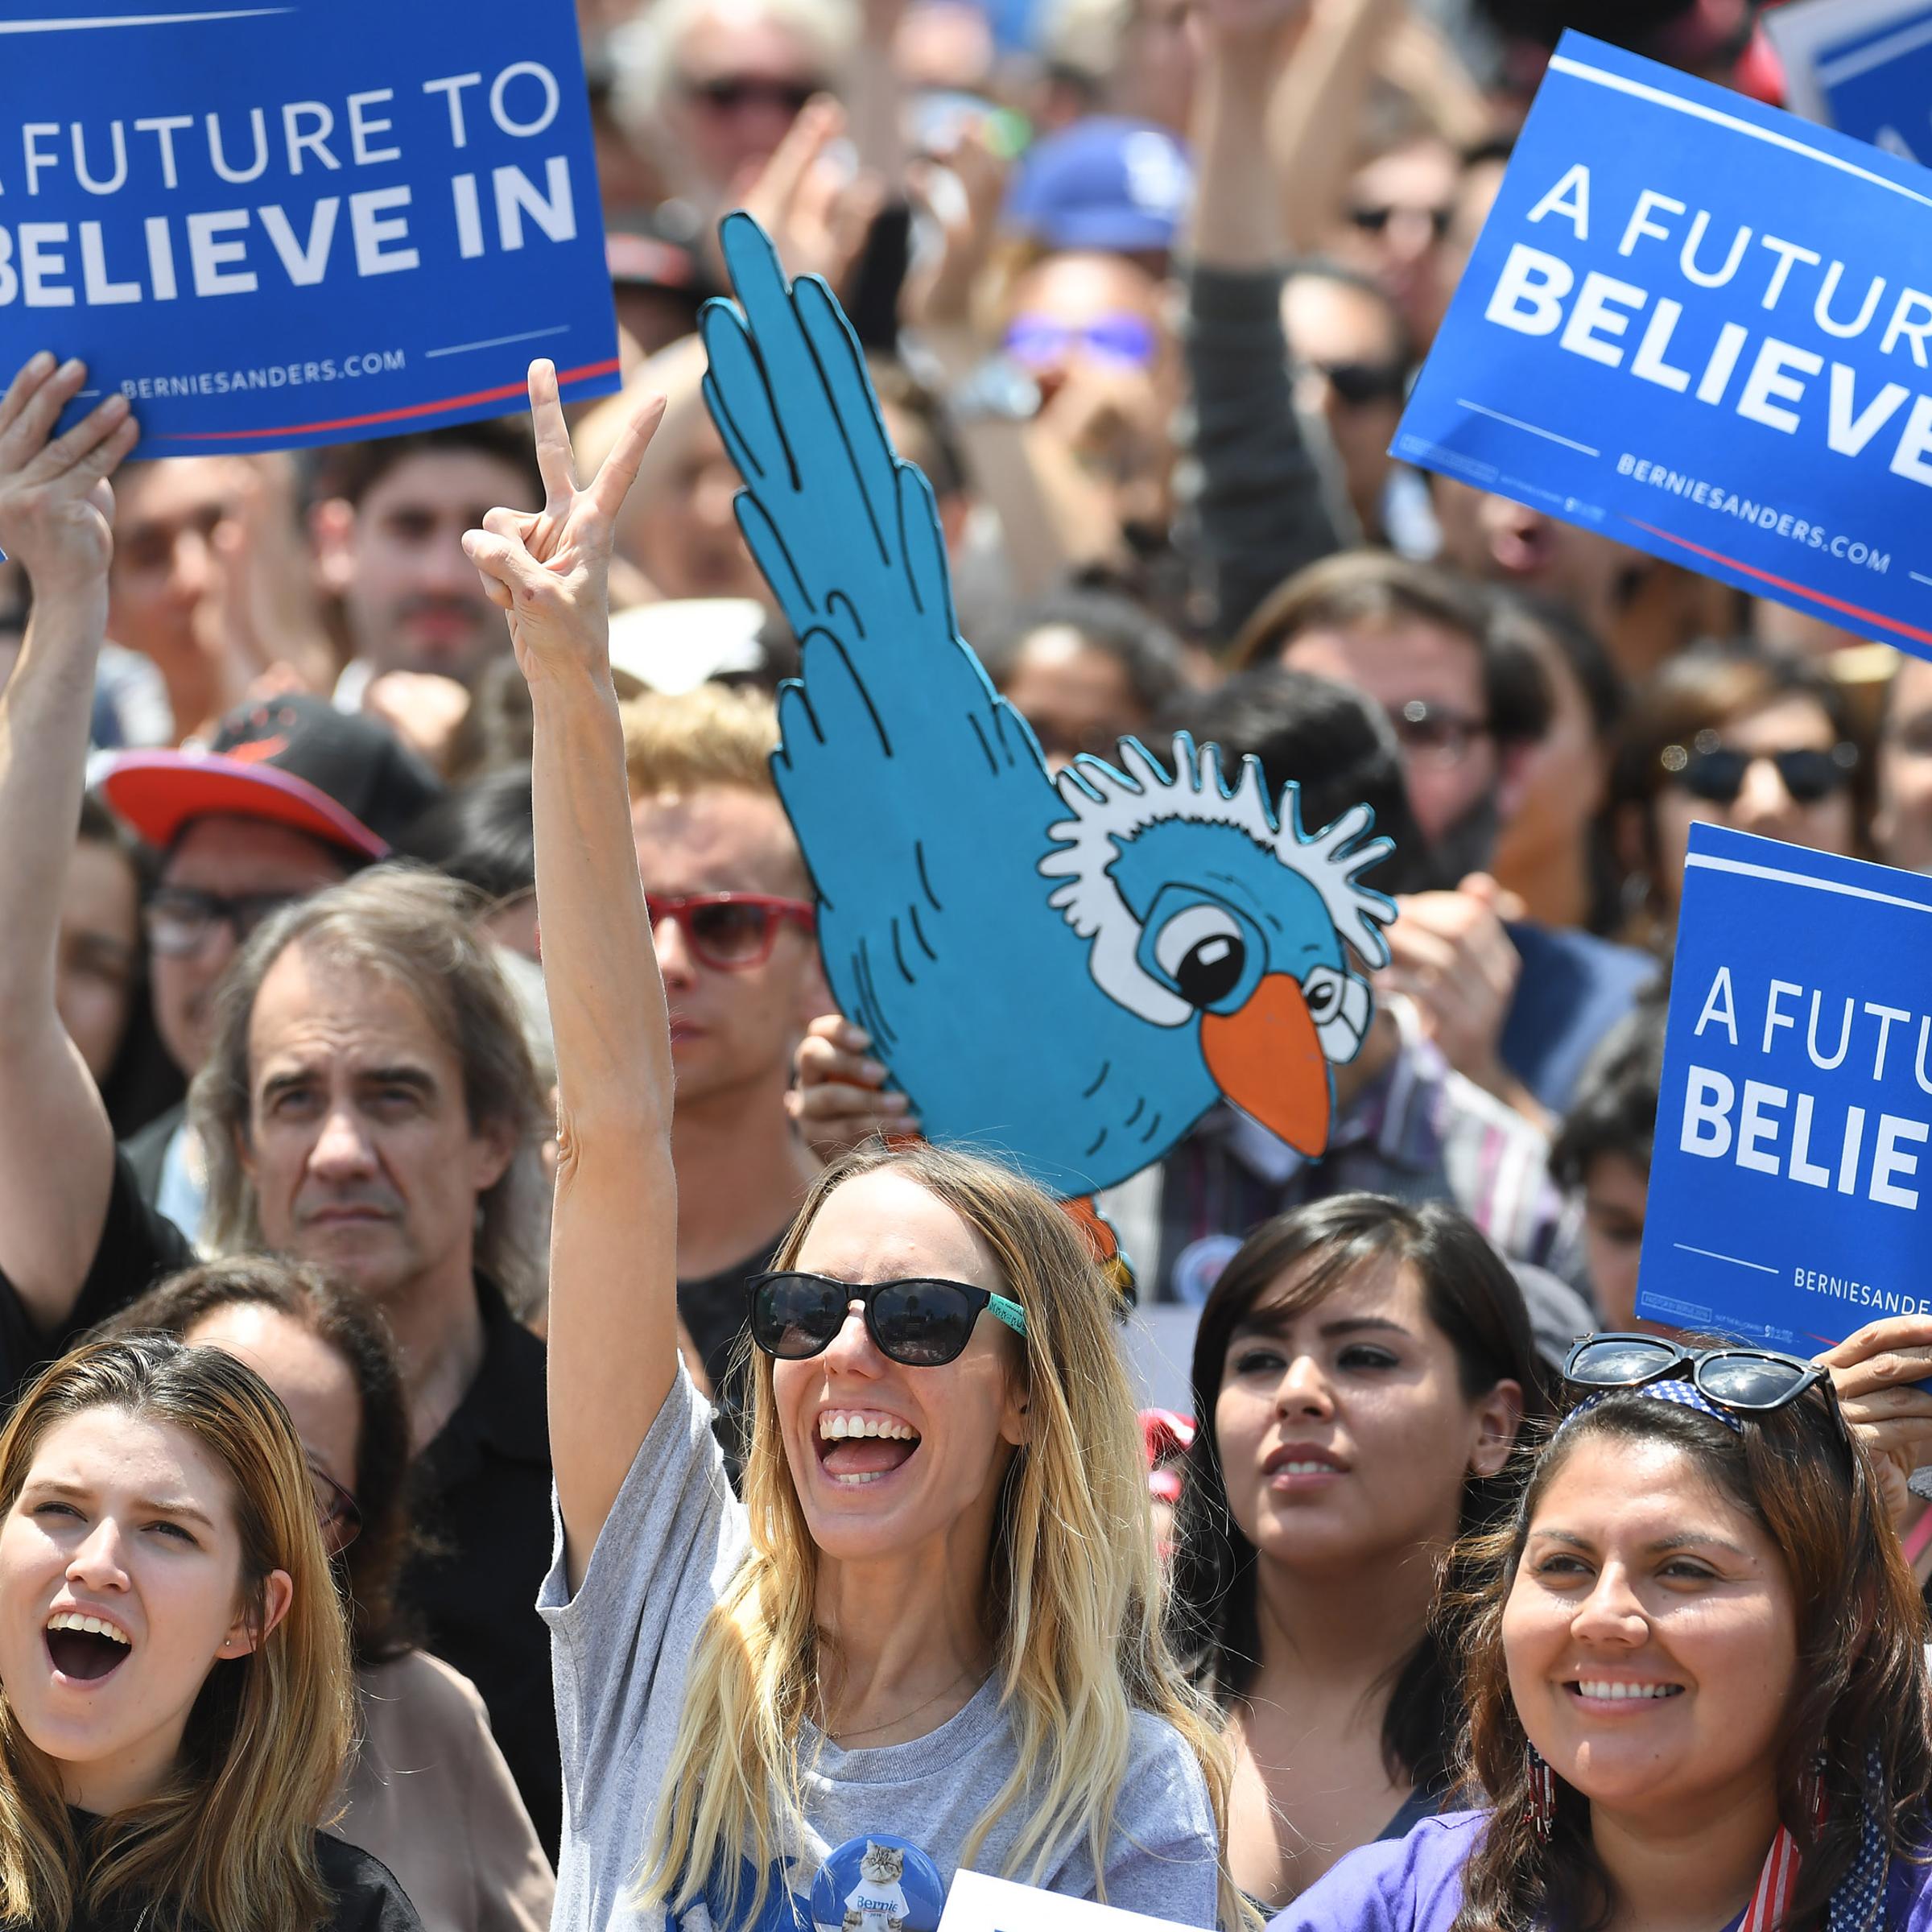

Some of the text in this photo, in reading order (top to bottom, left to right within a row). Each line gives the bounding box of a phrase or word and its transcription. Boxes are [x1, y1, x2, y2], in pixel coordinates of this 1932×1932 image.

[23, 61, 559, 196] FUTURE TO
[452, 155, 576, 259] IN
[1527, 163, 1932, 368] A FUTUR
[121, 349, 406, 399] BERNIESANDERS.COM
[1616, 452, 1891, 573] BERNIESANDERS.COM
[1694, 966, 1738, 1046] A
[1680, 1064, 1930, 1211] BELIE
[857, 1896, 898, 1913] Bernie
